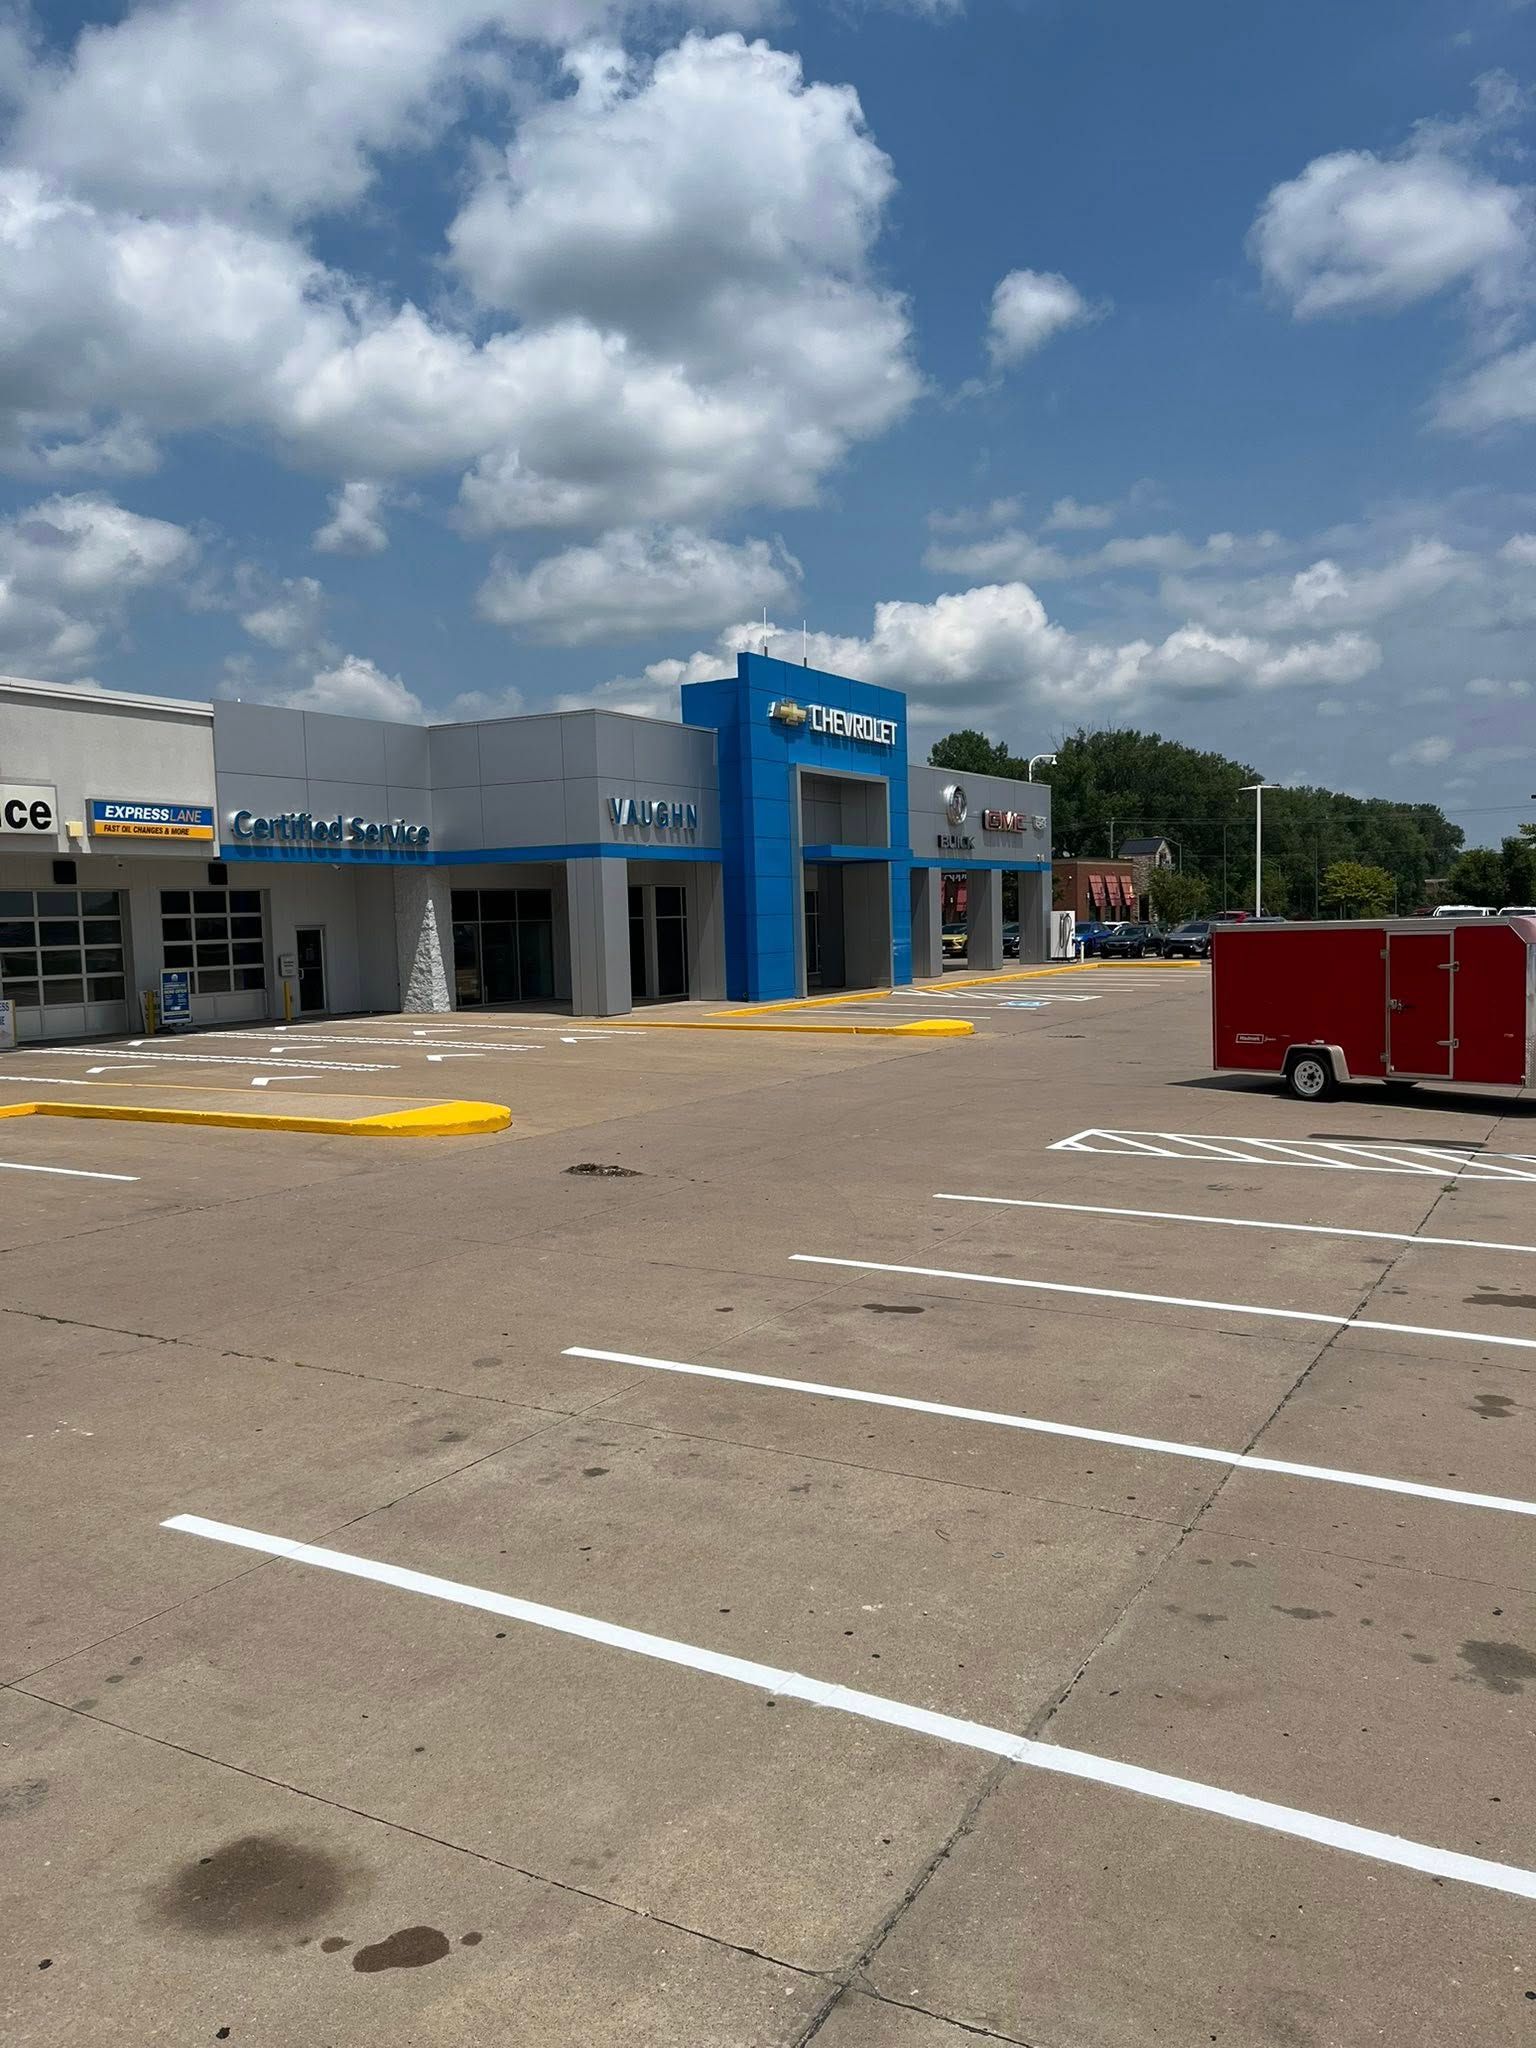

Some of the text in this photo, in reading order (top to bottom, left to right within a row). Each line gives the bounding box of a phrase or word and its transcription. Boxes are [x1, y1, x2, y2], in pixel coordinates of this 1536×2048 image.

[808, 704, 898, 745] CHEVROLET
[0, 799, 52, 830] ce
[233, 810, 430, 846] Certified Service
[608, 797, 697, 829] VAUGHN
[983, 809, 1027, 833] GMC
[103, 824, 190, 836] FAST OIL CHANGES & MORE
[938, 834, 975, 850] BUICK
